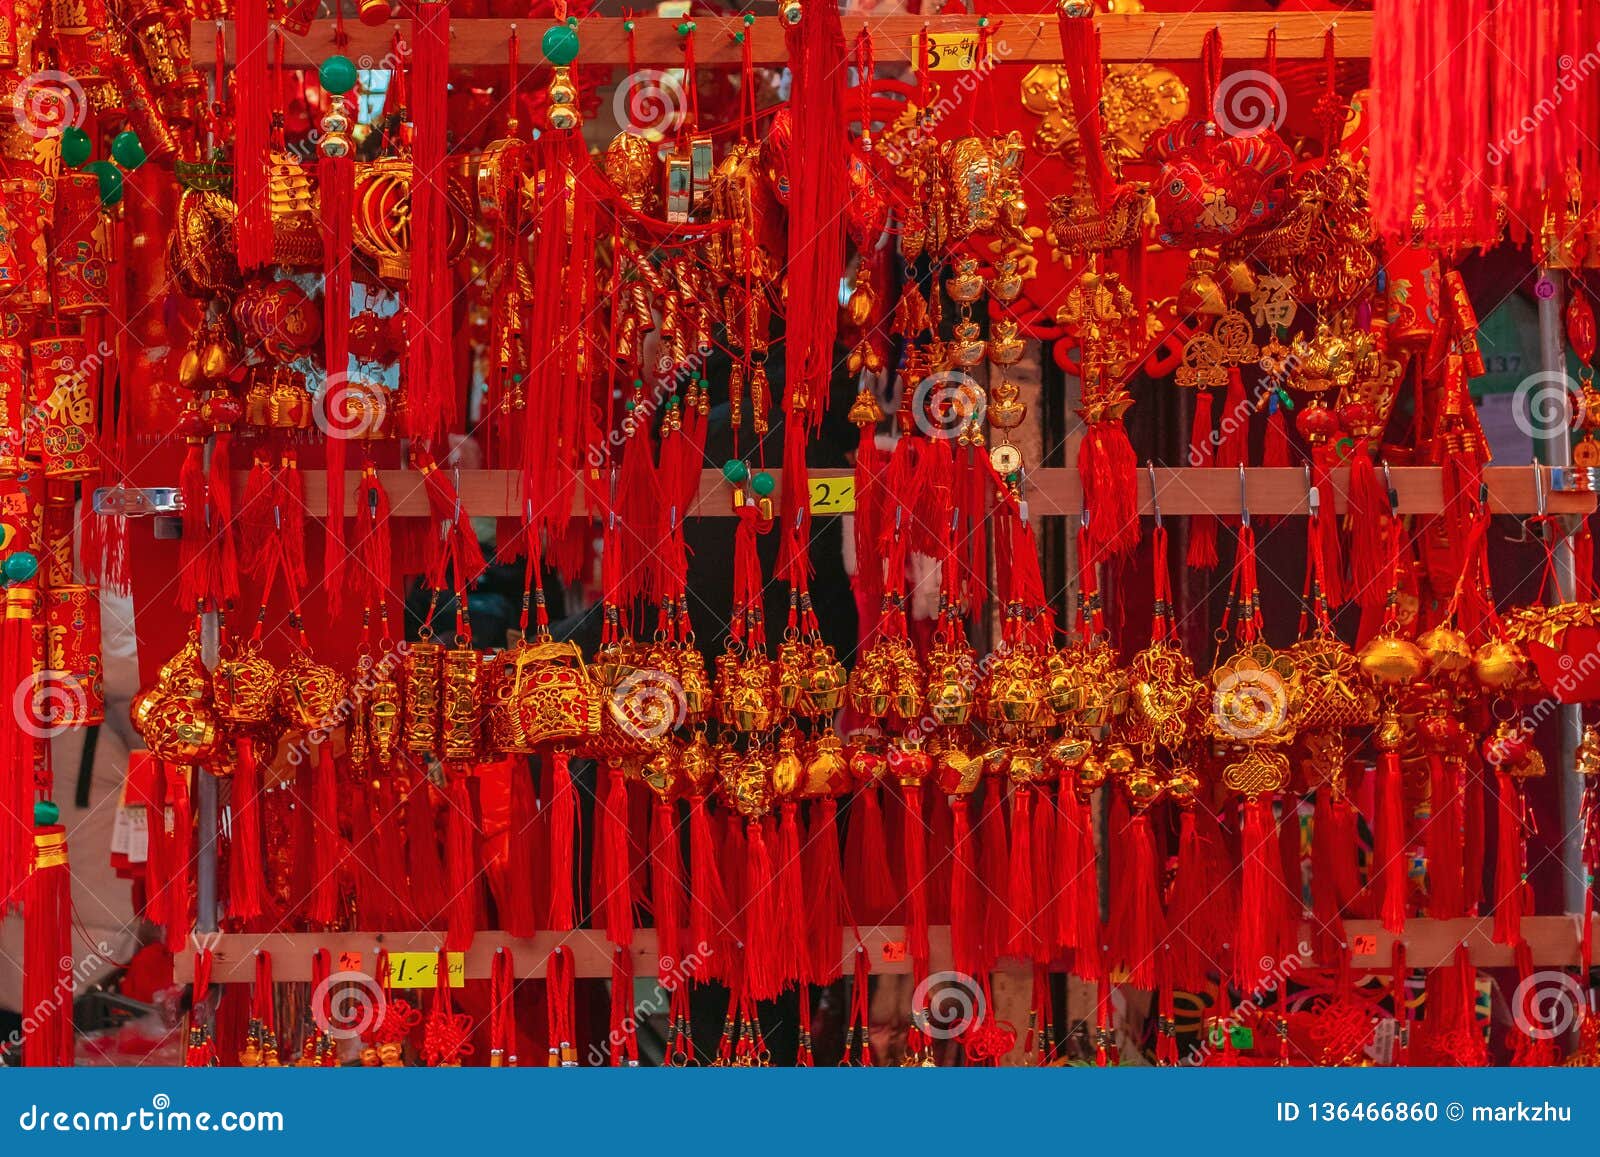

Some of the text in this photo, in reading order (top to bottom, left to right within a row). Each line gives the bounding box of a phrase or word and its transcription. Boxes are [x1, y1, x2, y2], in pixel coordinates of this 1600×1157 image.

[943, 45, 960, 57] FOR
[46, 371, 95, 426] 福
[433, 963, 463, 976] ECH
